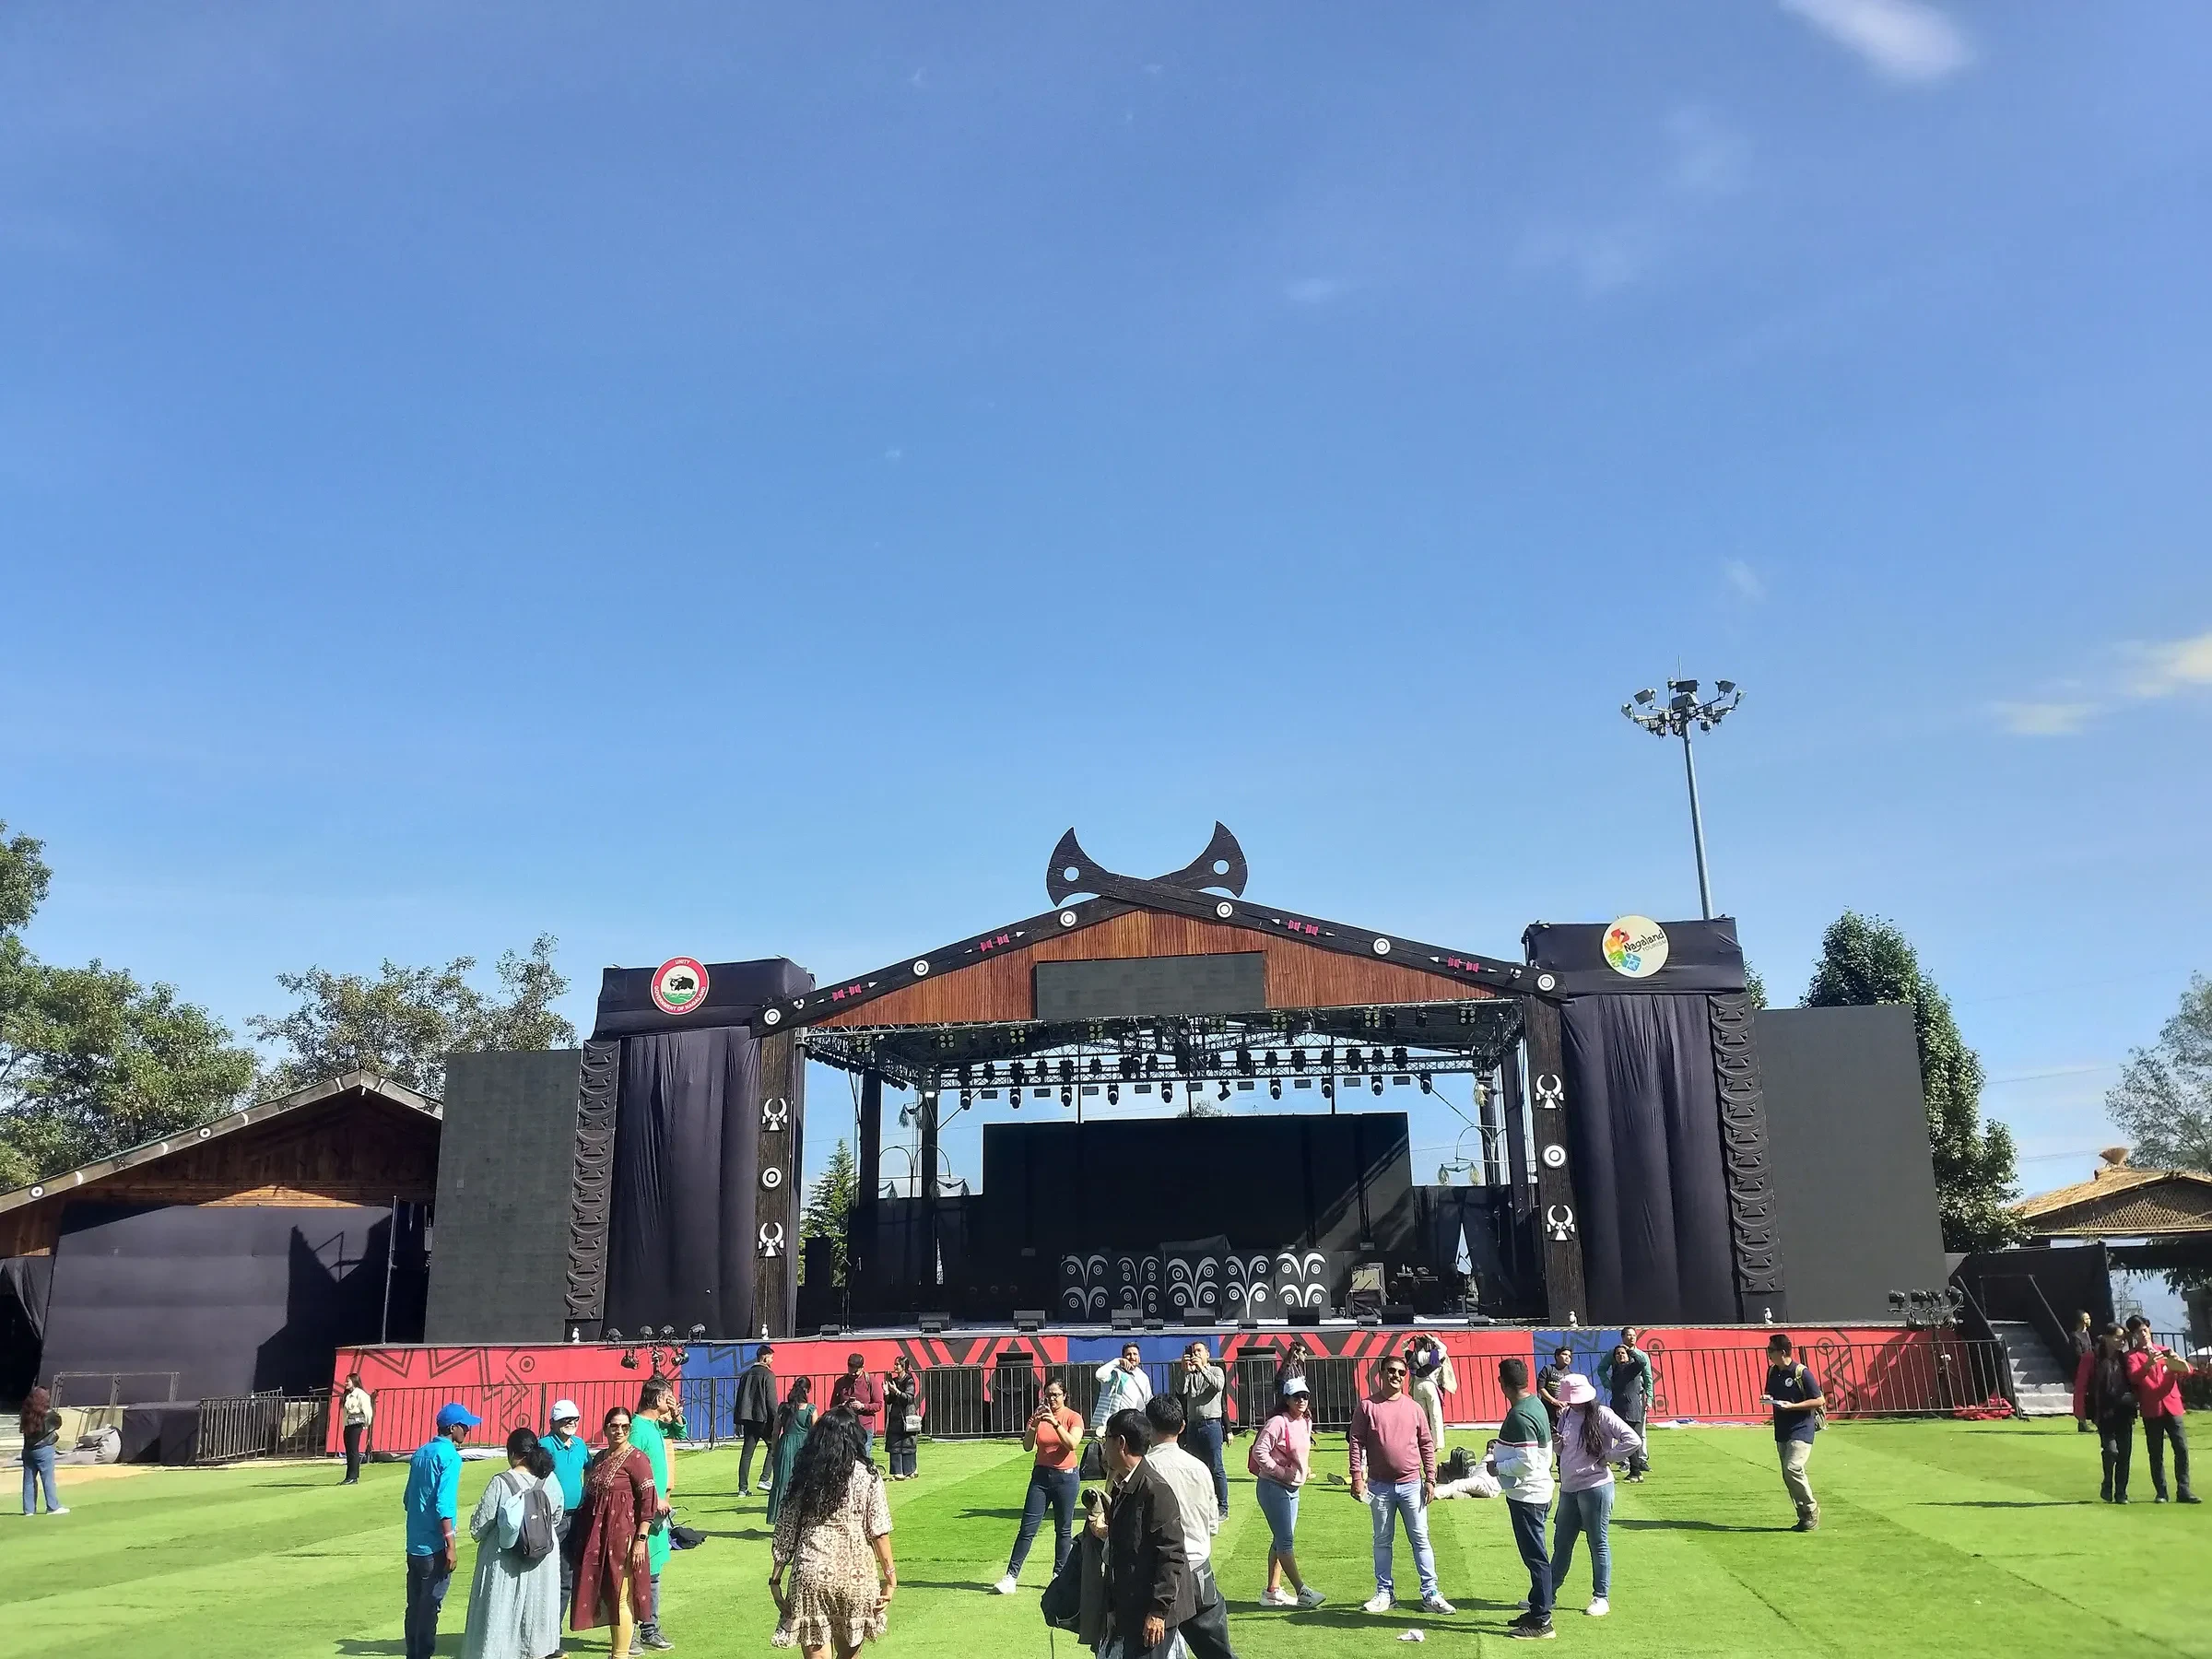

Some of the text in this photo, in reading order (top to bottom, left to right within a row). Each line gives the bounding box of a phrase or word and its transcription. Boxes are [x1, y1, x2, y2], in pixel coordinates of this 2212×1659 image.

[1624, 929, 1665, 952] Nagaland
[654, 986, 677, 1011] GOVERNMENT
[685, 987, 706, 1010] NAGALAND
